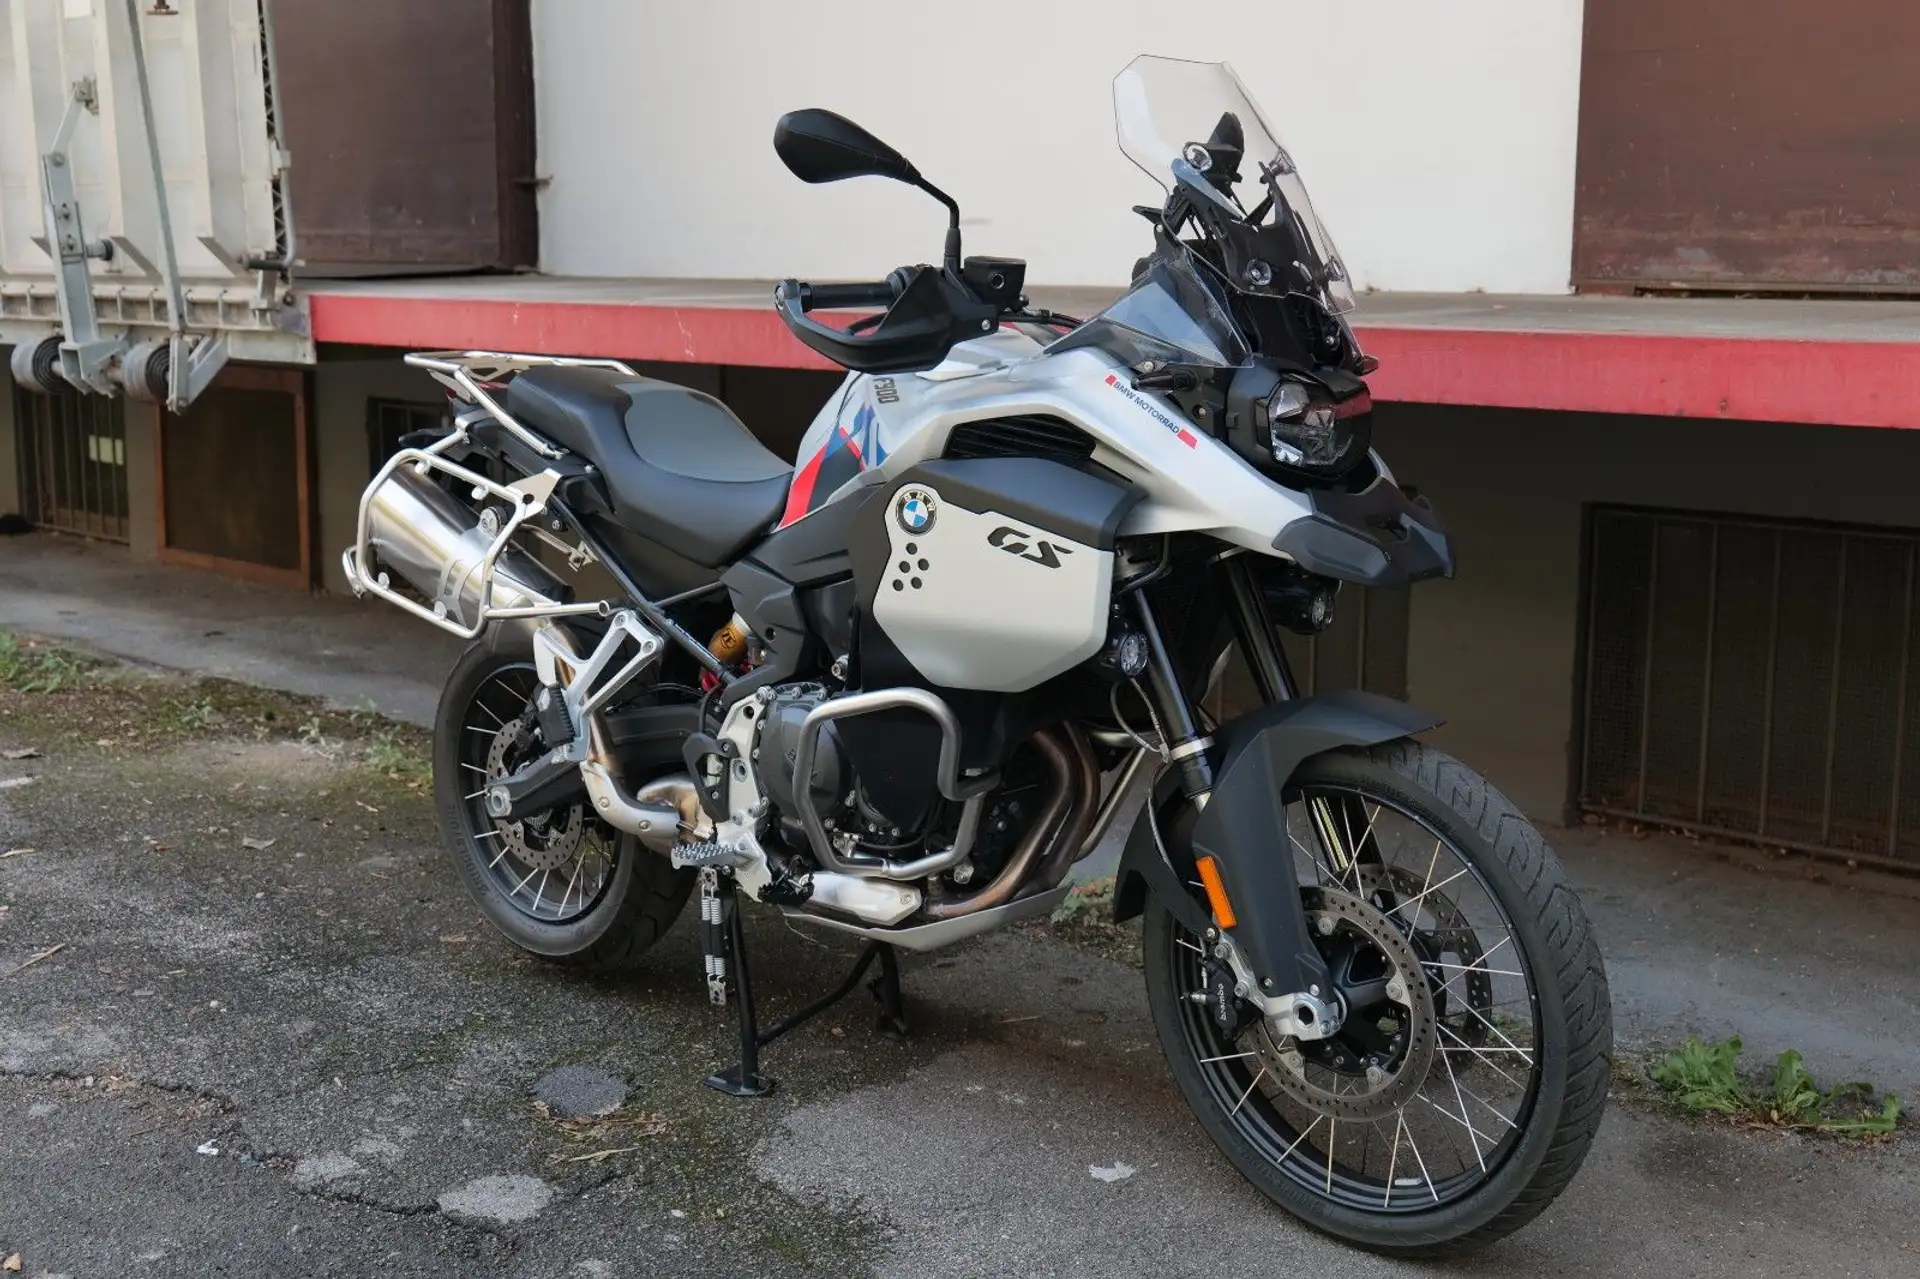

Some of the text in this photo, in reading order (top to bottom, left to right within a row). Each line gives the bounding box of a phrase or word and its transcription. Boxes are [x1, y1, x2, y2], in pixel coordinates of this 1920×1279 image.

[1113, 381, 1180, 434] BMW MOTORRAD
[903, 491, 936, 512] BMW
[987, 526, 1074, 569] GS
